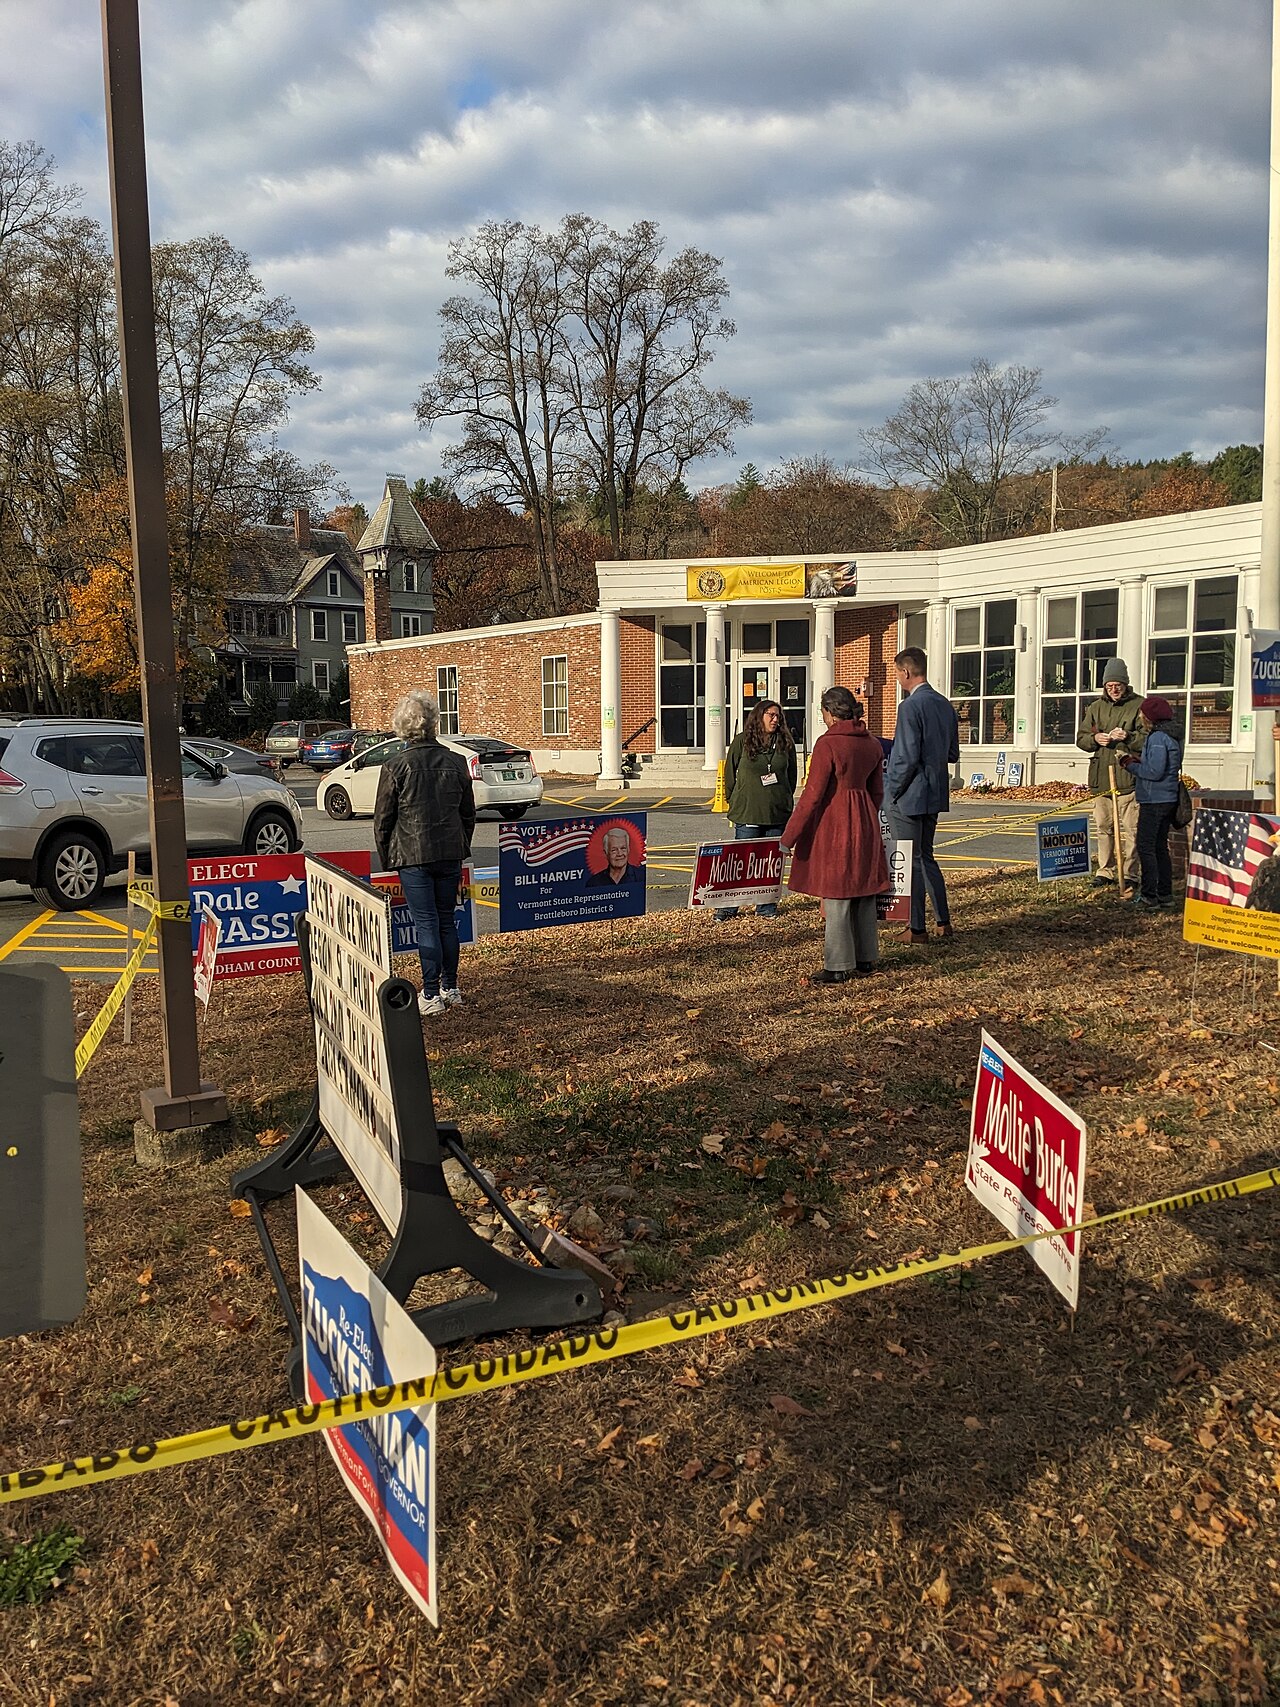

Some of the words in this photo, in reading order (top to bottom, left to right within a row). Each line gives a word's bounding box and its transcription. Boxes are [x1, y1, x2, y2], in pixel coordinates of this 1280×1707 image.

[520, 825, 547, 836] VOTE
[1042, 826, 1059, 836] RICK
[1043, 832, 1084, 848] MORTON
[1042, 848, 1069, 858] VERMONT
[1069, 846, 1086, 855] STATE
[709, 853, 744, 883] Mollie
[746, 850, 782, 880] Burke
[1054, 856, 1075, 865] SENATE
[191, 863, 258, 881] ELECT
[514, 875, 538, 886] BILL
[540, 869, 584, 883] HARVEY
[540, 887, 552, 895] For
[724, 888, 779, 898] Representative
[192, 887, 260, 914] Dale
[518, 899, 552, 910] Vermont
[552, 896, 573, 905] State
[574, 891, 630, 904] Representative
[534, 908, 579, 921] Brattleboro
[579, 906, 608, 915] District
[1211, 914, 1248, 928] Strengthening
[1222, 907, 1245, 917] Veterans
[1247, 911, 1258, 919] and
[1188, 918, 1200, 926] Come
[1216, 926, 1235, 935] inquire
[1236, 928, 1254, 937] about
[1230, 939, 1263, 950] welcome
[1265, 945, 1272, 953] in
[983, 1076, 1031, 1176] Mollie
[1034, 1116, 1076, 1226] Burke
[975, 1162, 1000, 1192] State
[339, 1304, 374, 1373] Re-Elect
[378, 1455, 426, 1532] GOVERNOR
